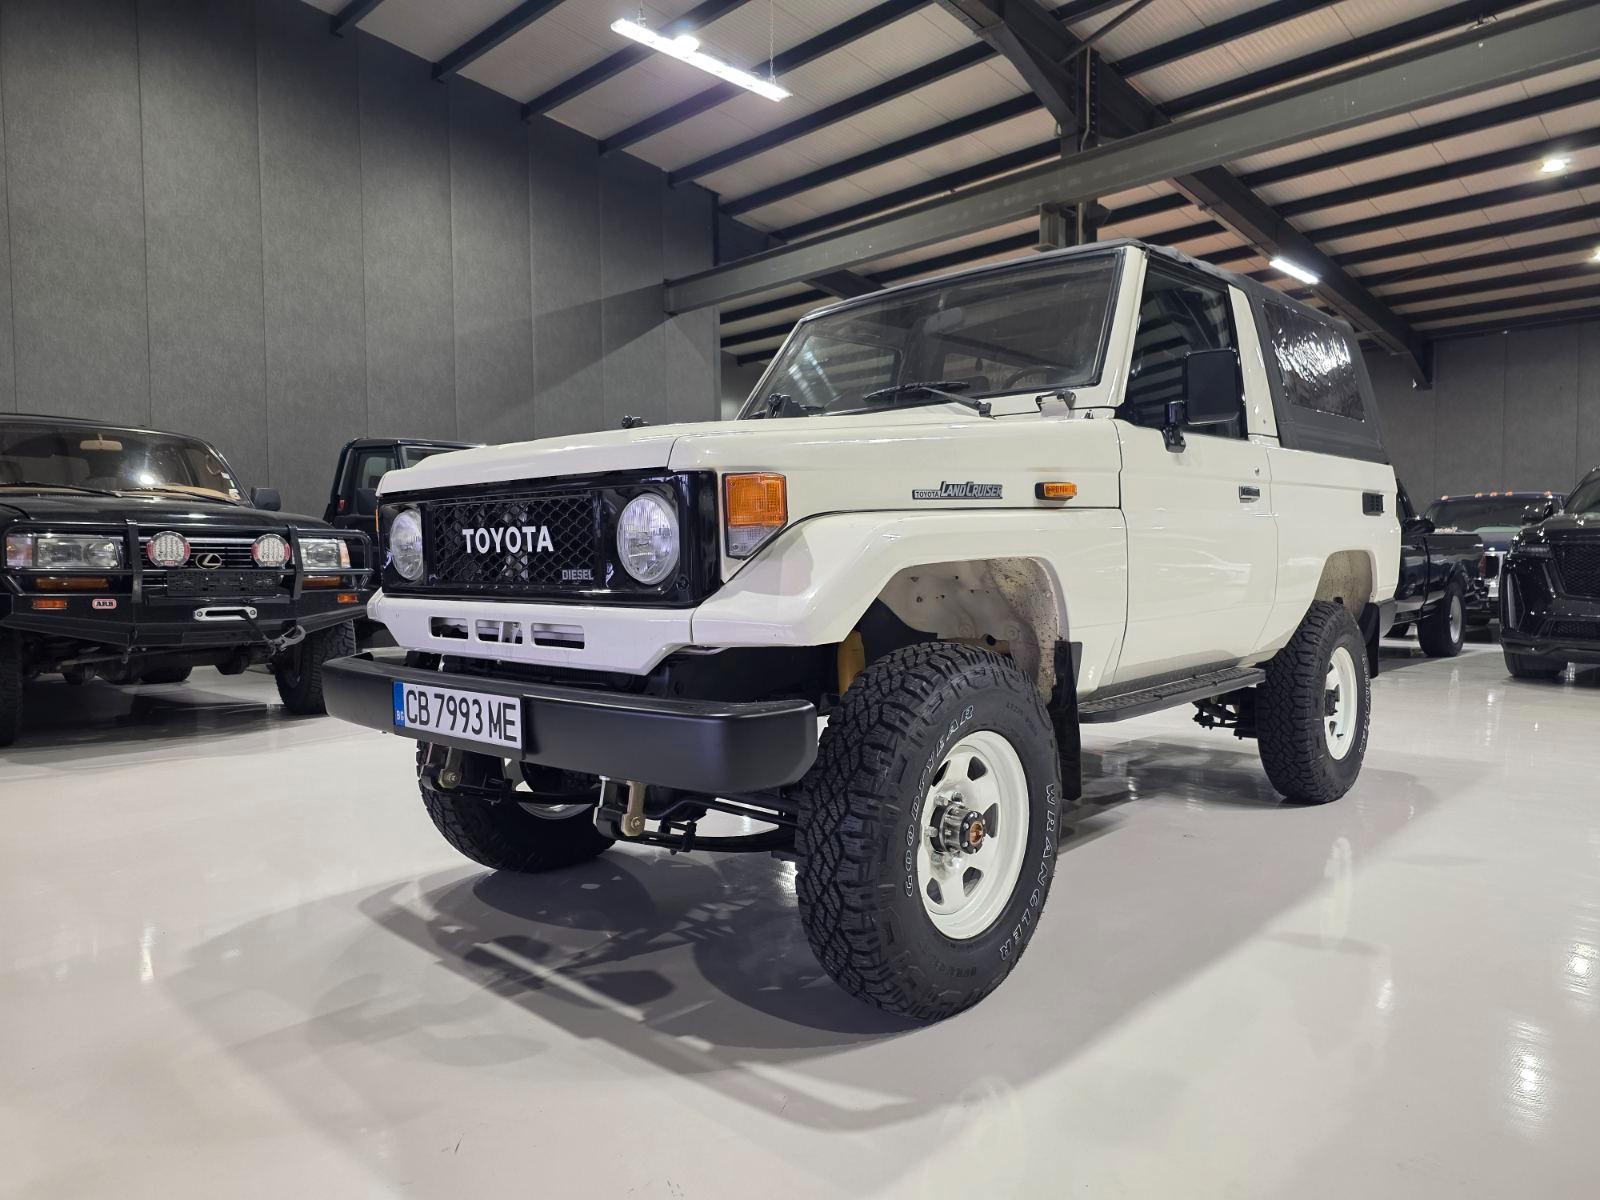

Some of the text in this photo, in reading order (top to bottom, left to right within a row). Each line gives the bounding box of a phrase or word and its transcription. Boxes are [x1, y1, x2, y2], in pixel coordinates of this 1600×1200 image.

[462, 525, 554, 553] TOYOTA
[561, 568, 594, 581] DIESEL
[396, 710, 404, 721] BG
[406, 689, 518, 743] CB 7993 ME
[904, 705, 974, 897] GOODYEAR
[999, 783, 1056, 961] WRANGLER
